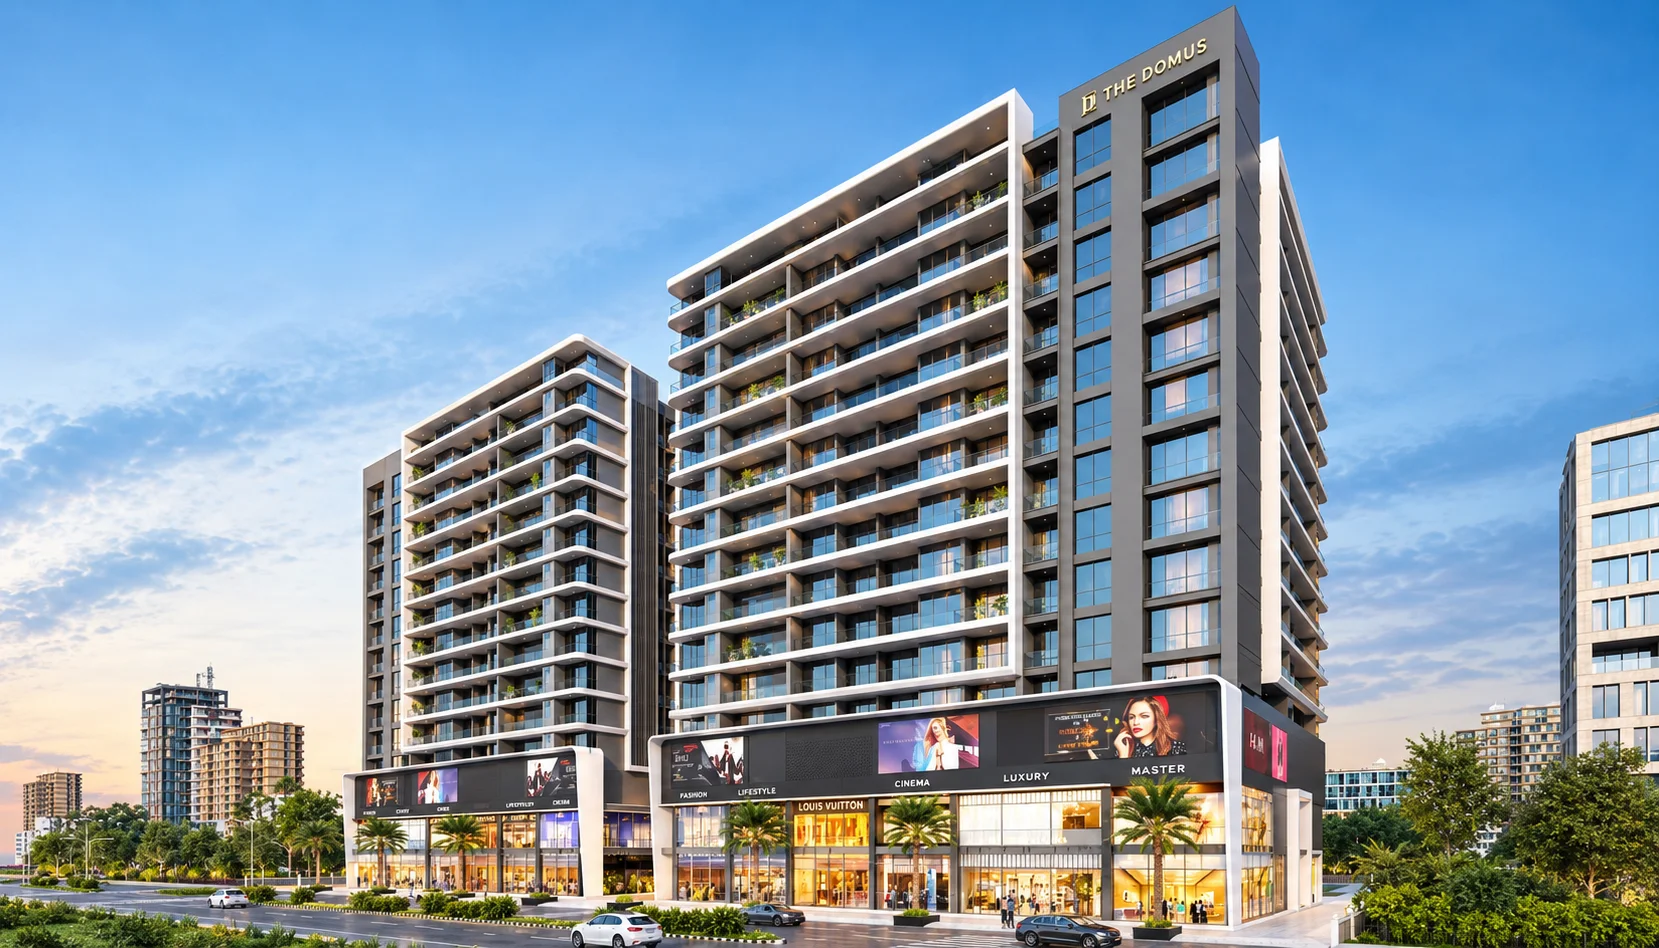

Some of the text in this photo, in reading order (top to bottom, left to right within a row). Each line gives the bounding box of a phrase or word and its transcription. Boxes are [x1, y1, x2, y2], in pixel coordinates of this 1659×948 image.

[1103, 38, 1207, 102] THE DOMUS
[1131, 764, 1185, 776] MASTER
[1003, 771, 1050, 783] LUXURY
[894, 778, 930, 788] CINEMA
[680, 791, 708, 799] FASHION
[738, 787, 776, 796] LIFESTYLE
[798, 800, 864, 811] LOUIS VUITTON
